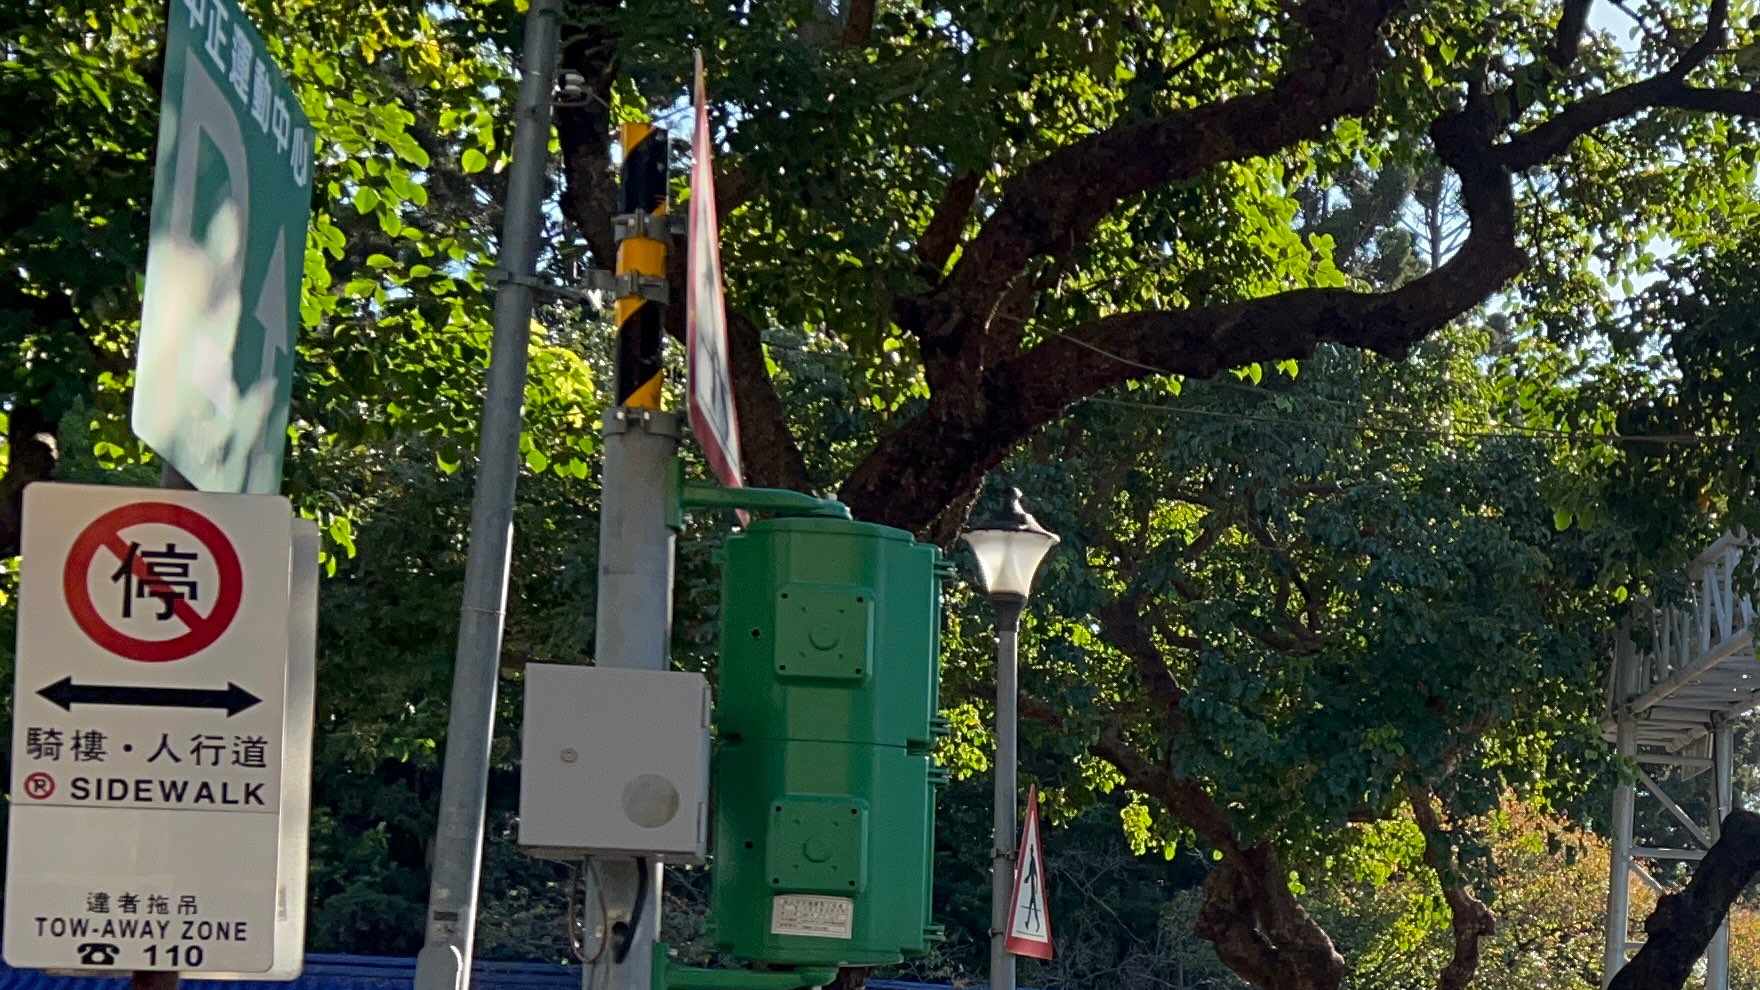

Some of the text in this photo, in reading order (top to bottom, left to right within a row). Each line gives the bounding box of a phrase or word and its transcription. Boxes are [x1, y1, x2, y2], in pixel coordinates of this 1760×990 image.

[111, 541, 198, 621] 停
[70, 777, 266, 805] SIDEWALK
[87, 891, 199, 916] 違者拖吊
[34, 917, 248, 941] TOW-AWAY ZONE
[143, 944, 204, 967] 110
